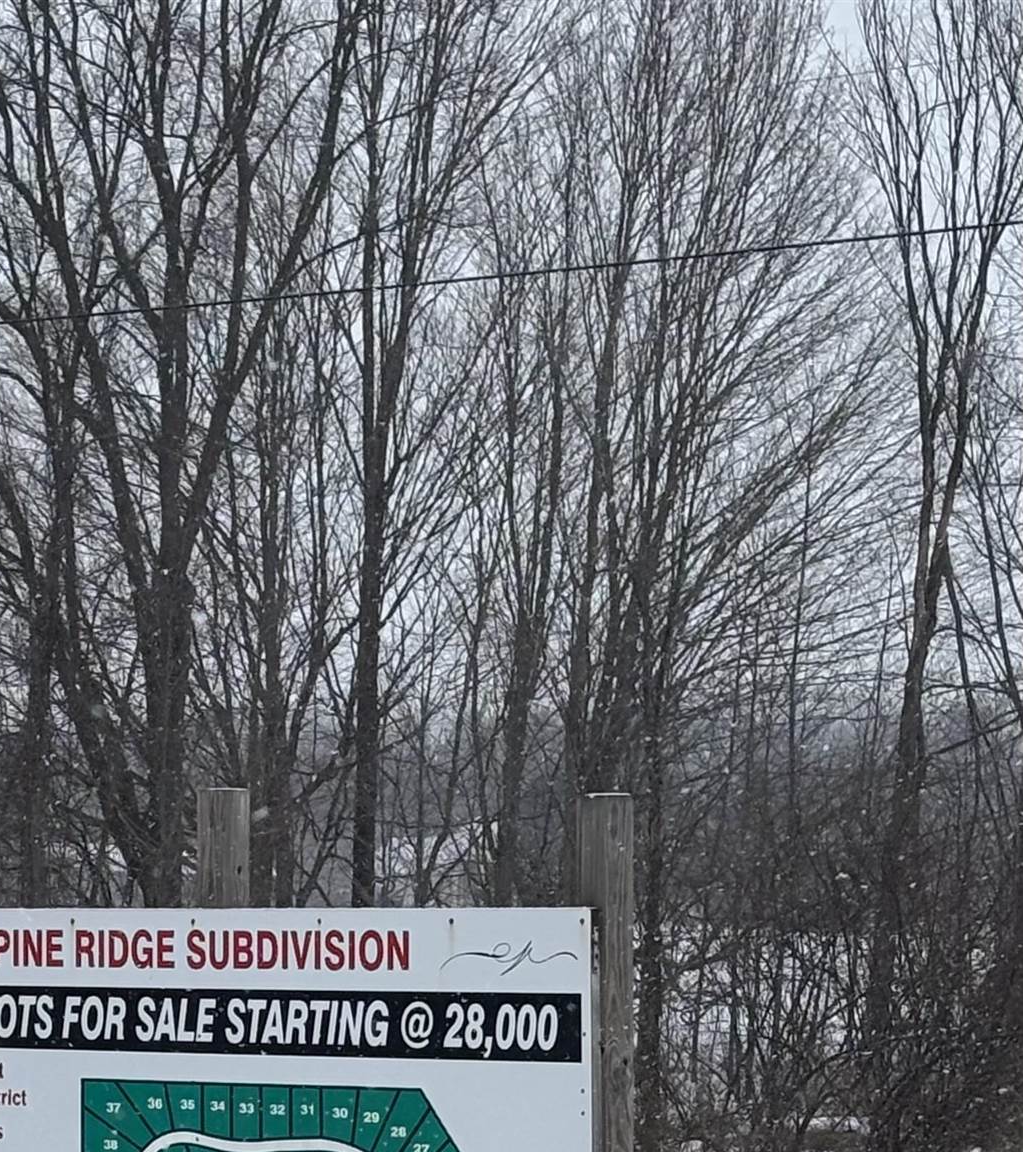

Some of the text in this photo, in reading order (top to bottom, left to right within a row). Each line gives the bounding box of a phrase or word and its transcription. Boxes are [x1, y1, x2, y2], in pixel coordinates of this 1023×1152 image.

[76, 929, 175, 969] RIDGE
[186, 929, 409, 971] SUBDIVISION
[62, 996, 127, 1041] FOR
[135, 996, 216, 1044] SALE
[224, 998, 390, 1048] STARTING
[400, 1001, 434, 1049] @
[443, 1003, 559, 1059] 28,000
[106, 1103, 121, 1113] 37
[147, 1097, 163, 1109] 36
[181, 1100, 195, 1109] 35
[210, 1101, 225, 1111] 34
[239, 1103, 254, 1113] 33
[270, 1105, 285, 1115] 32
[300, 1105, 314, 1115] 31
[332, 1108, 348, 1119] 30
[363, 1112, 379, 1123] 29
[390, 1127, 406, 1137] 28
[104, 1140, 118, 1150] 38
